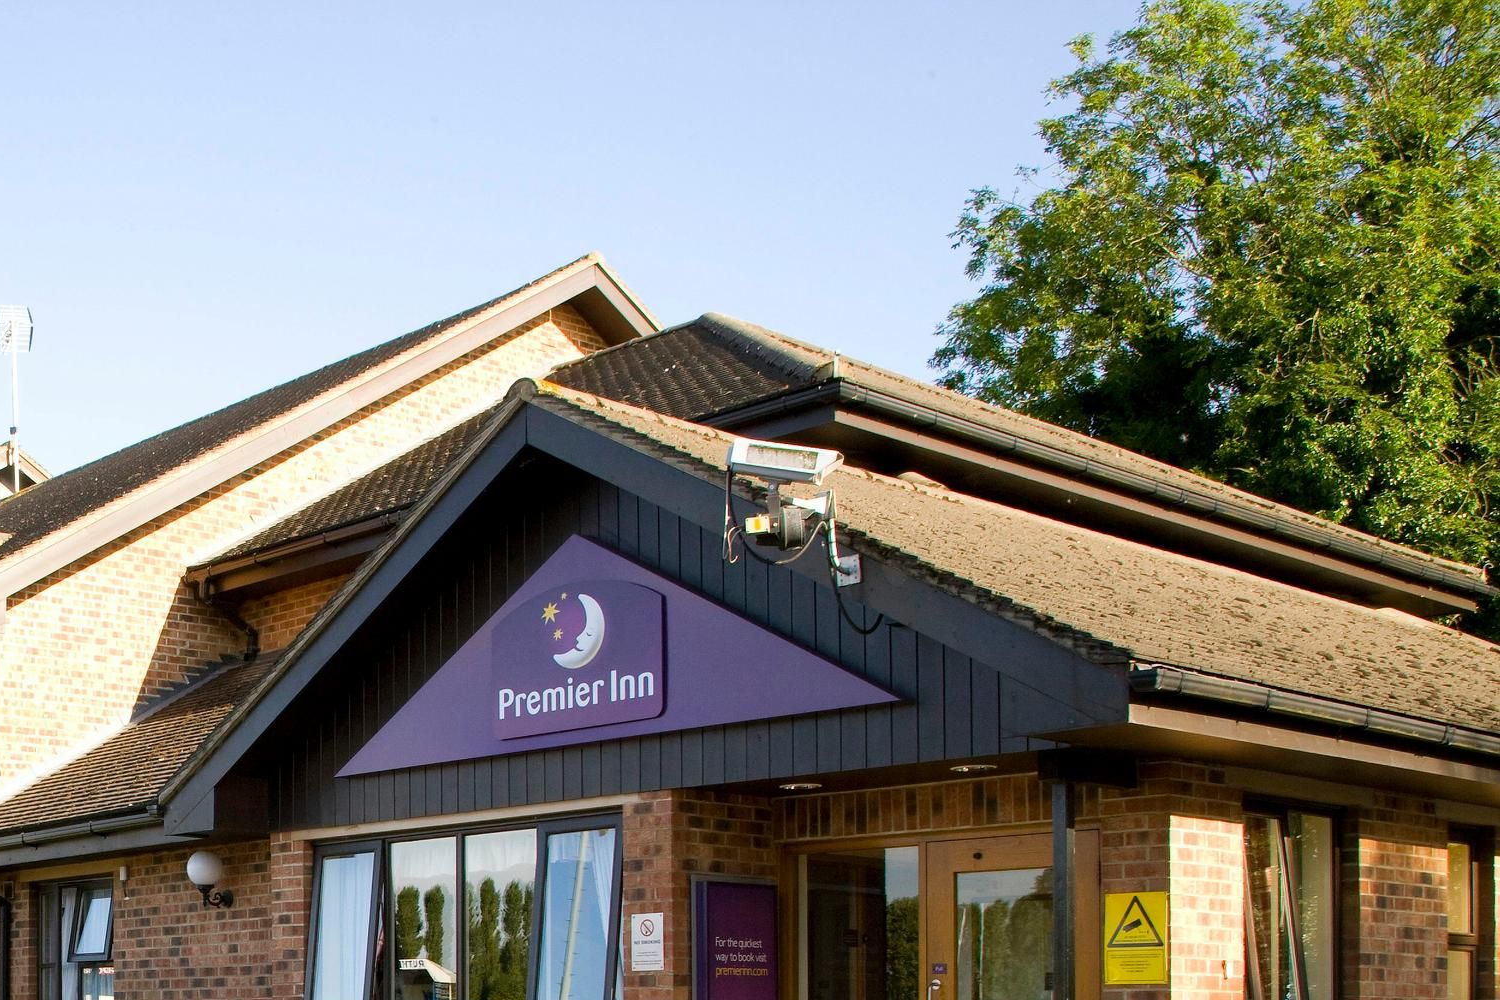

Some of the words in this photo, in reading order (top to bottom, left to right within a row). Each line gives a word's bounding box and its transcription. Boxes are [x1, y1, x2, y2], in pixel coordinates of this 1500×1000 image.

[499, 677, 604, 720] Premier
[610, 669, 654, 702] Inn
[715, 936, 726, 947] For
[727, 937, 738, 948] the
[739, 939, 762, 950] quickest
[715, 953, 729, 964] way
[730, 953, 738, 962] to
[738, 952, 755, 962] book
[755, 952, 767, 963] visit
[715, 967, 768, 978] premierinn.com
